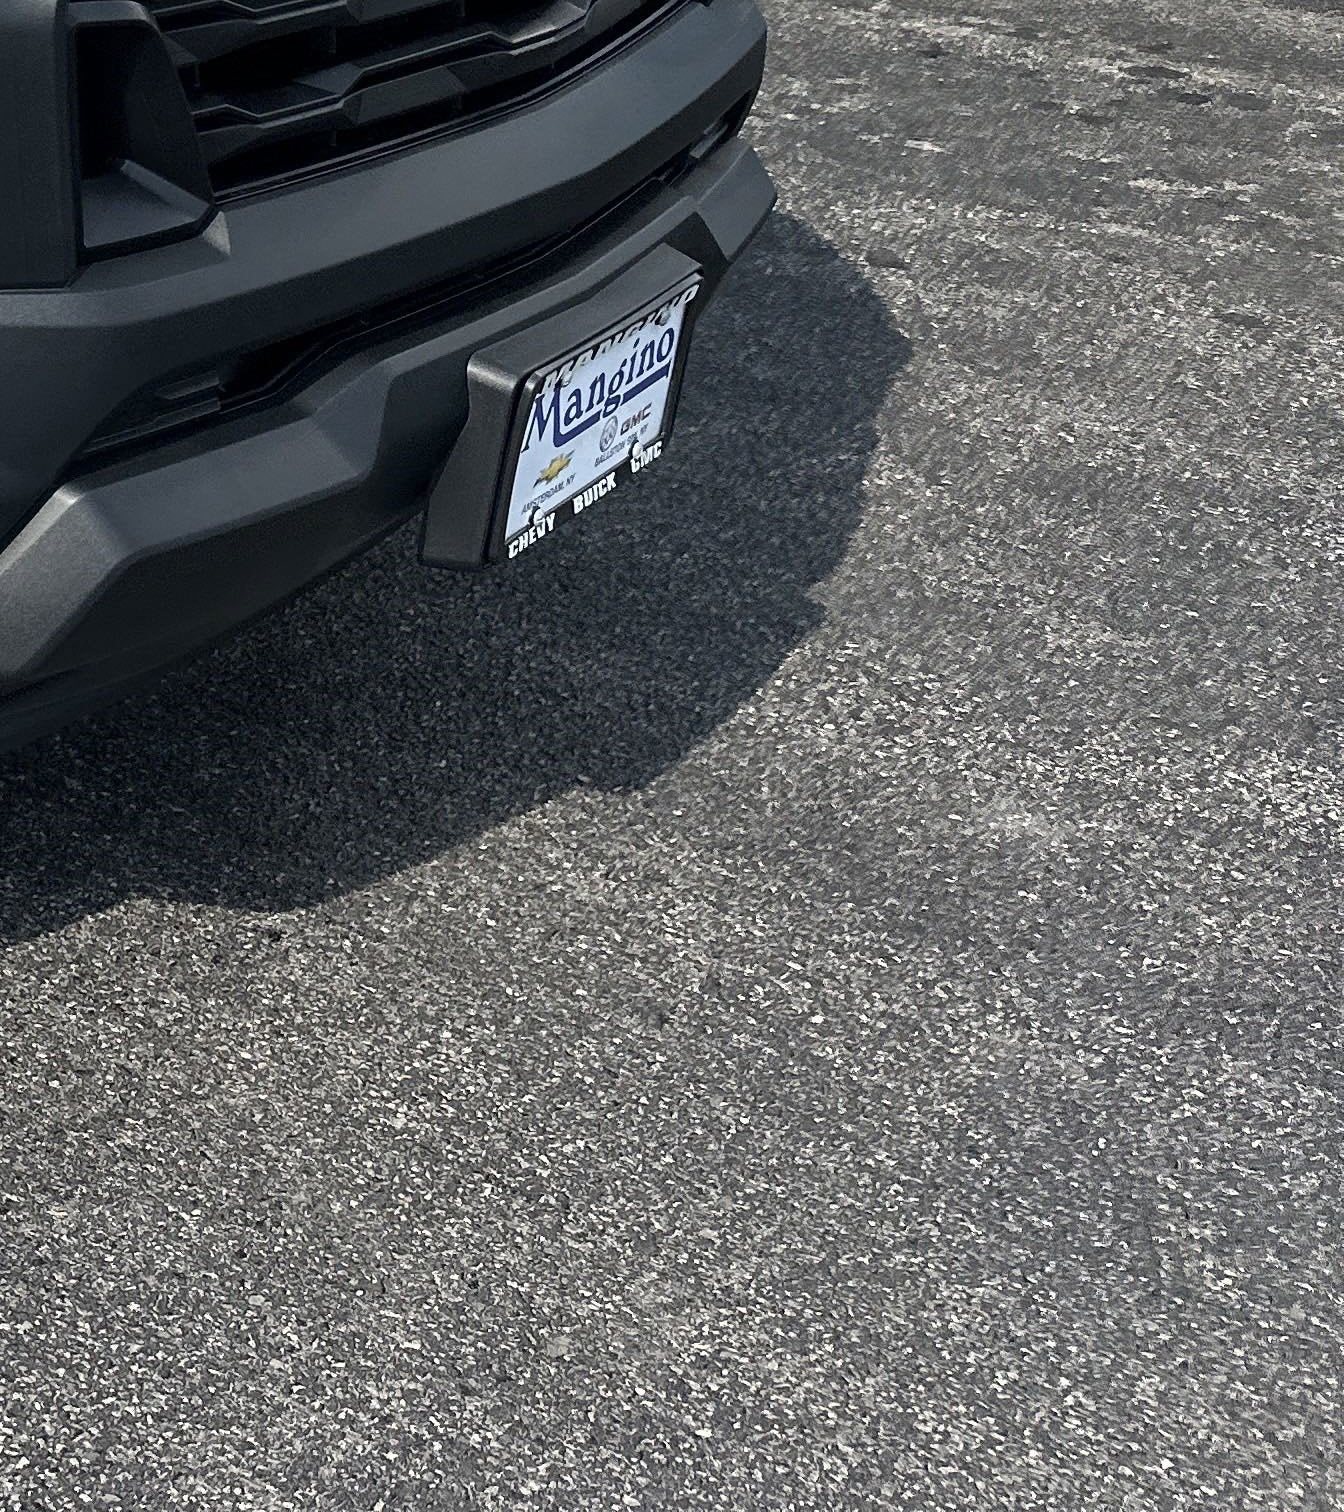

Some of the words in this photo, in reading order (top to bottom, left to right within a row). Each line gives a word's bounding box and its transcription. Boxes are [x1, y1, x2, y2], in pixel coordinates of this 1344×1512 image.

[520, 327, 674, 454] Mangino
[620, 401, 653, 436] GMC
[508, 512, 556, 560] CHEVY
[572, 471, 617, 515] BUICK
[630, 440, 663, 474] GMC
